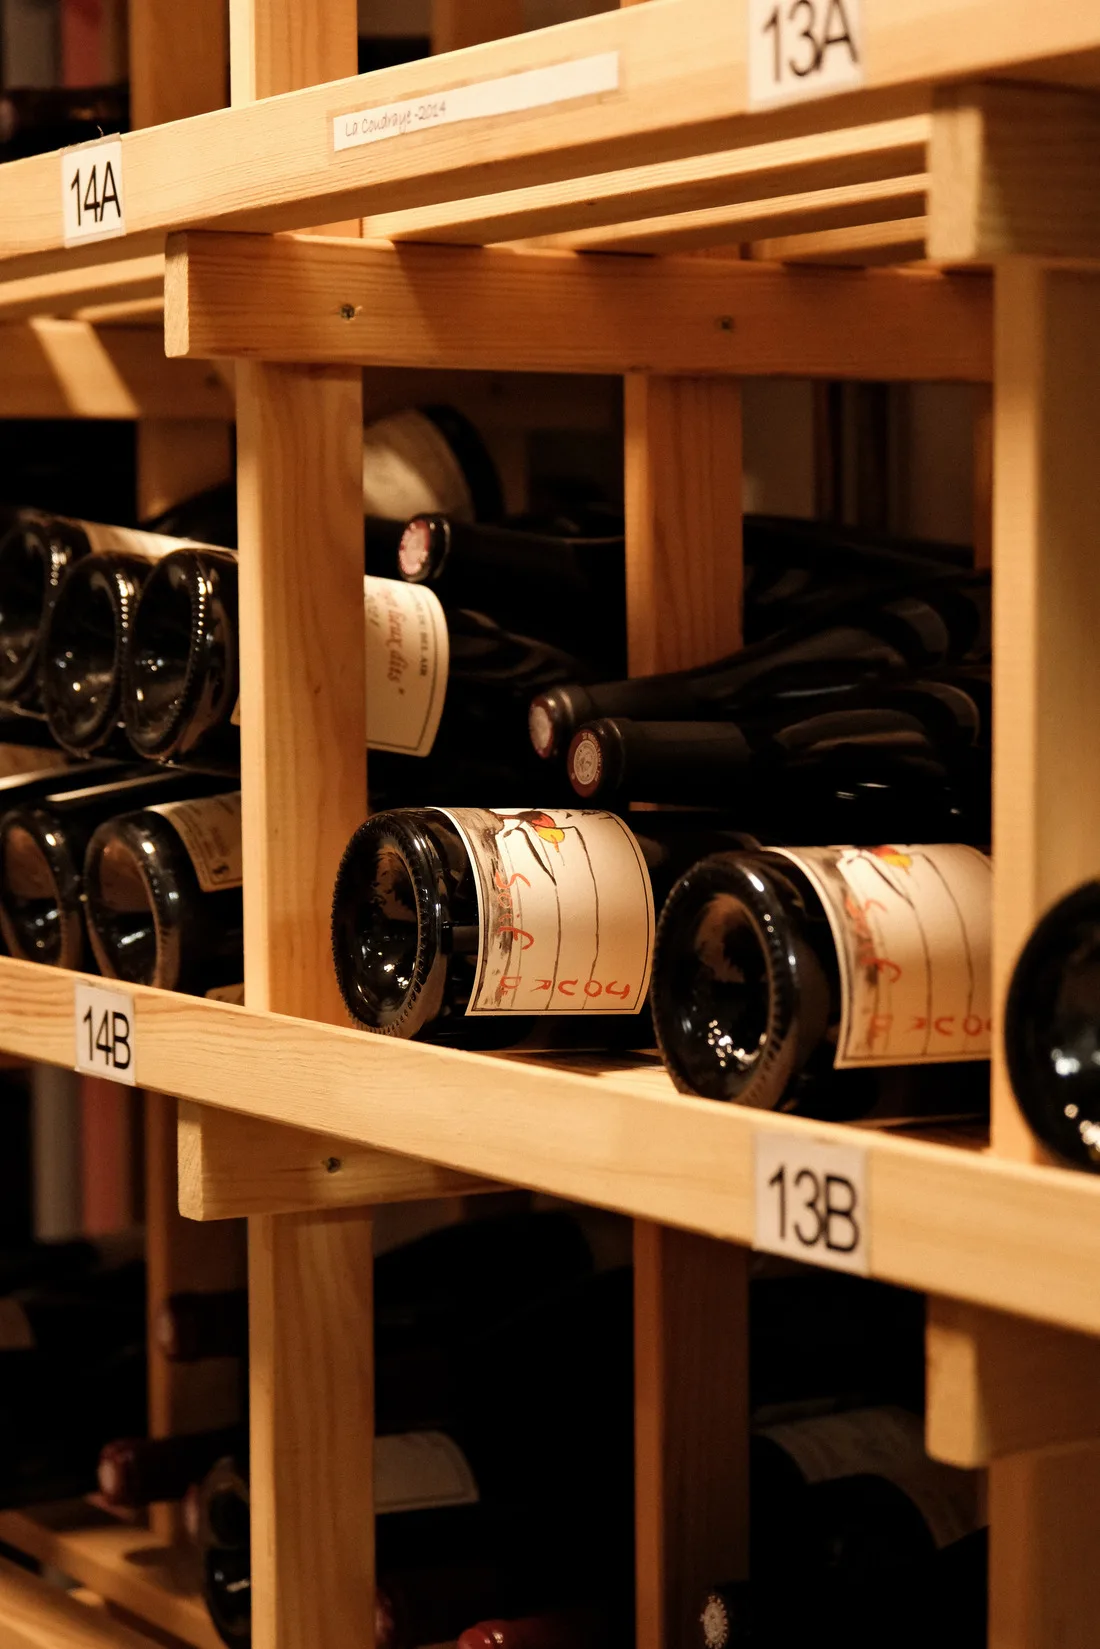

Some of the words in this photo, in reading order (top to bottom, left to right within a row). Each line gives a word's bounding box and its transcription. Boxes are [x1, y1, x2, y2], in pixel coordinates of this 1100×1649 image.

[763, 0, 859, 83] 13A
[71, 161, 121, 226] 14A
[83, 1005, 131, 1070] 14B
[768, 1164, 860, 1254] 13B
